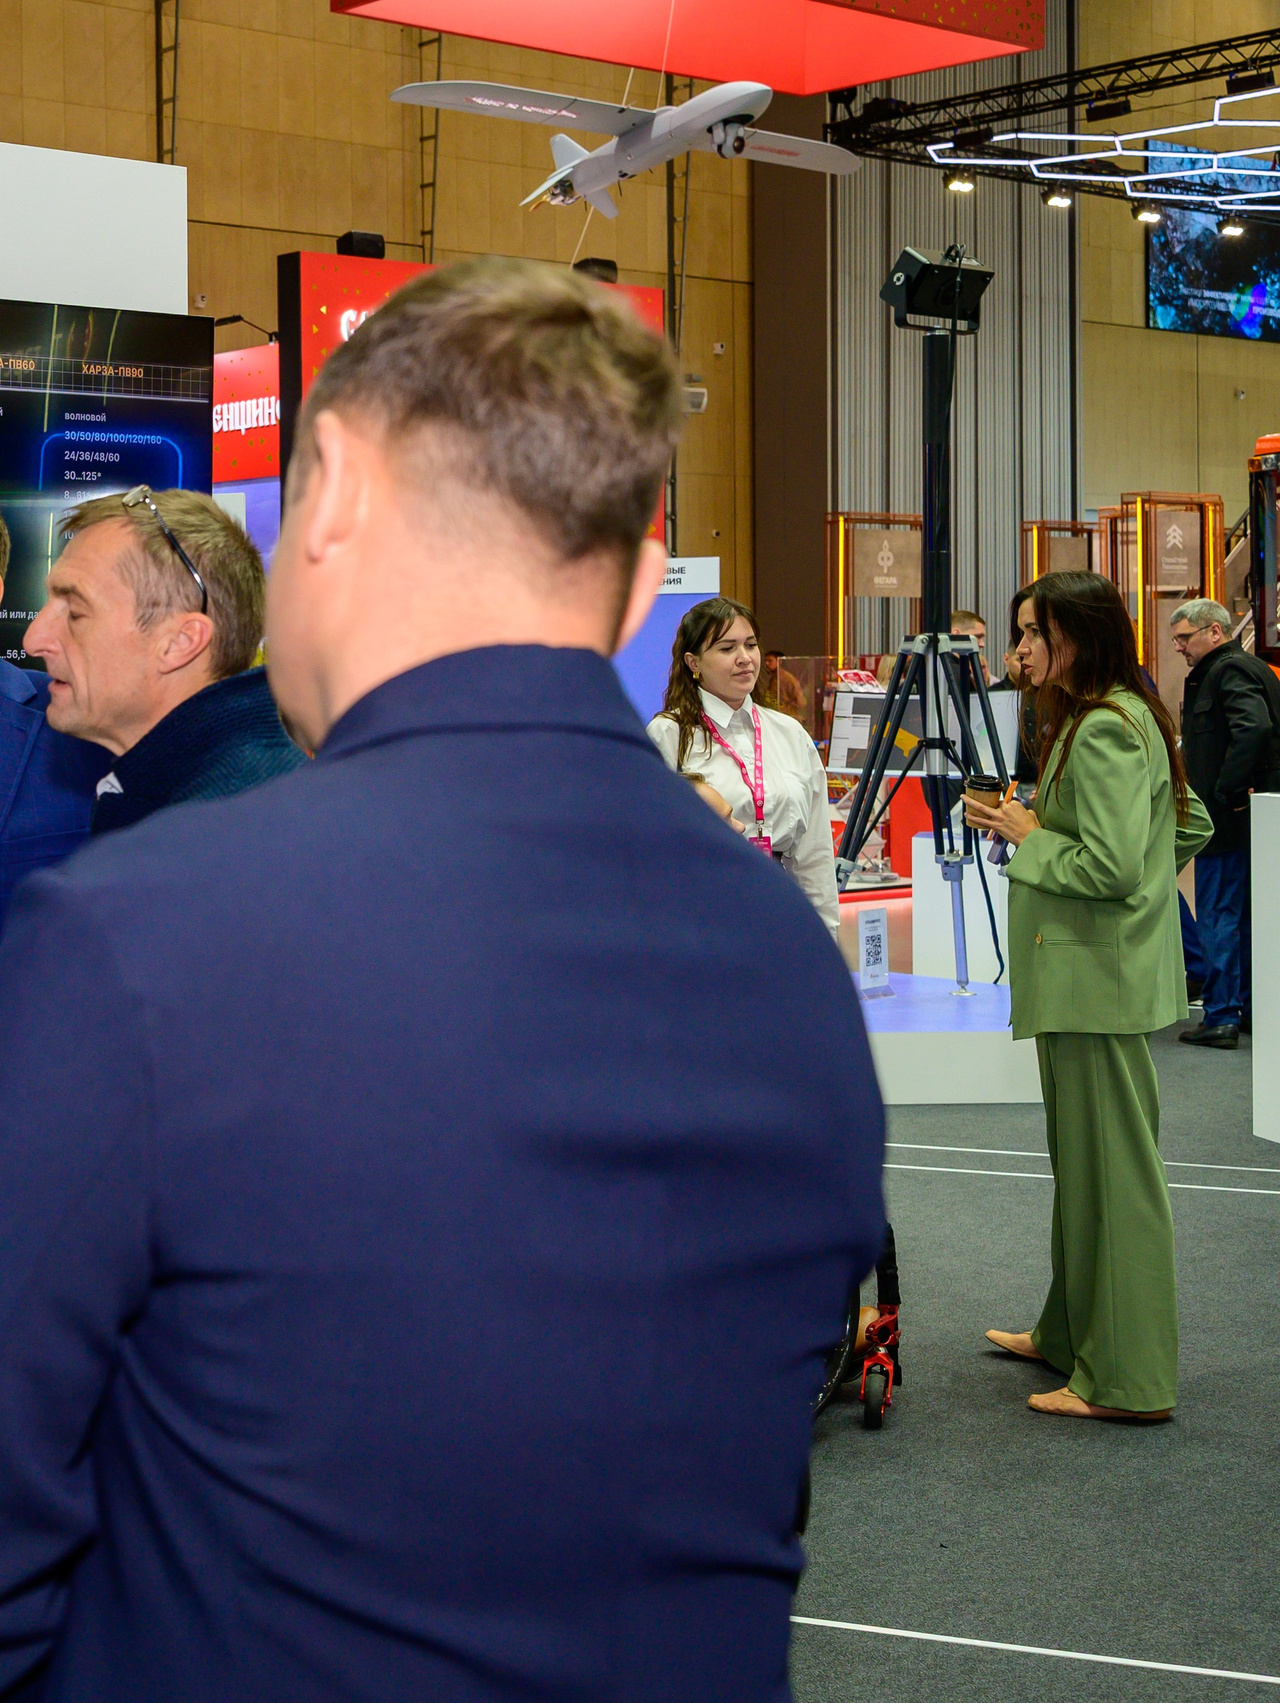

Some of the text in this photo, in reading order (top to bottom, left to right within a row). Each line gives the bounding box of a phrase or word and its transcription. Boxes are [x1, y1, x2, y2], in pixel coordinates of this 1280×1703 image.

[82, 364, 143, 377] ХАРЗА-ПВ90
[65, 412, 106, 422] волновой
[64, 431, 161, 445] 30/50/80/100/120/160
[64, 451, 120, 462] 24/36/48/60
[9, 611, 26, 619] или
